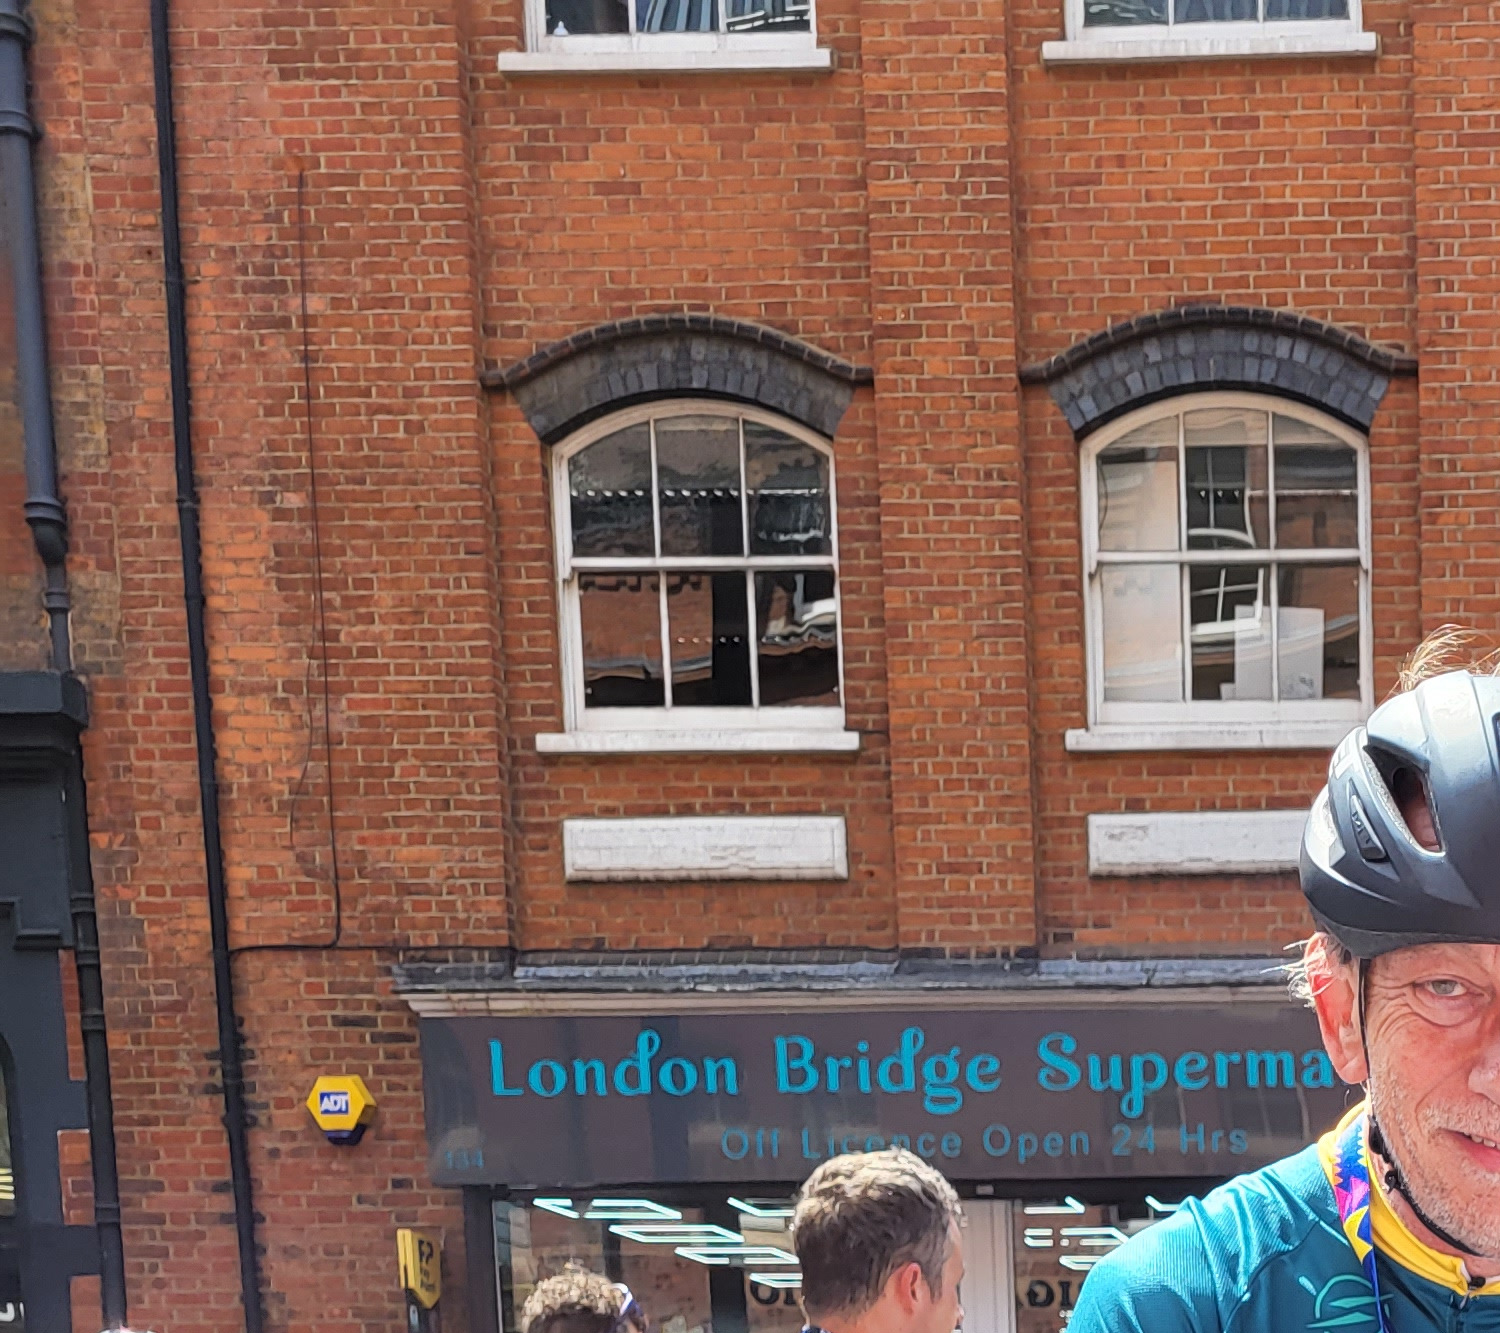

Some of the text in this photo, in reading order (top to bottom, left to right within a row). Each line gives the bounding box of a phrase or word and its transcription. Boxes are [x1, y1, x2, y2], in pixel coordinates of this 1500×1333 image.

[488, 1026, 1336, 1118] London Bridge Superma
[319, 1092, 349, 1114] ADT
[720, 1127, 782, 1160] Off
[983, 1125, 1090, 1165] Open
[1110, 1125, 1154, 1157] 24
[1180, 1123, 1250, 1157] Hrs
